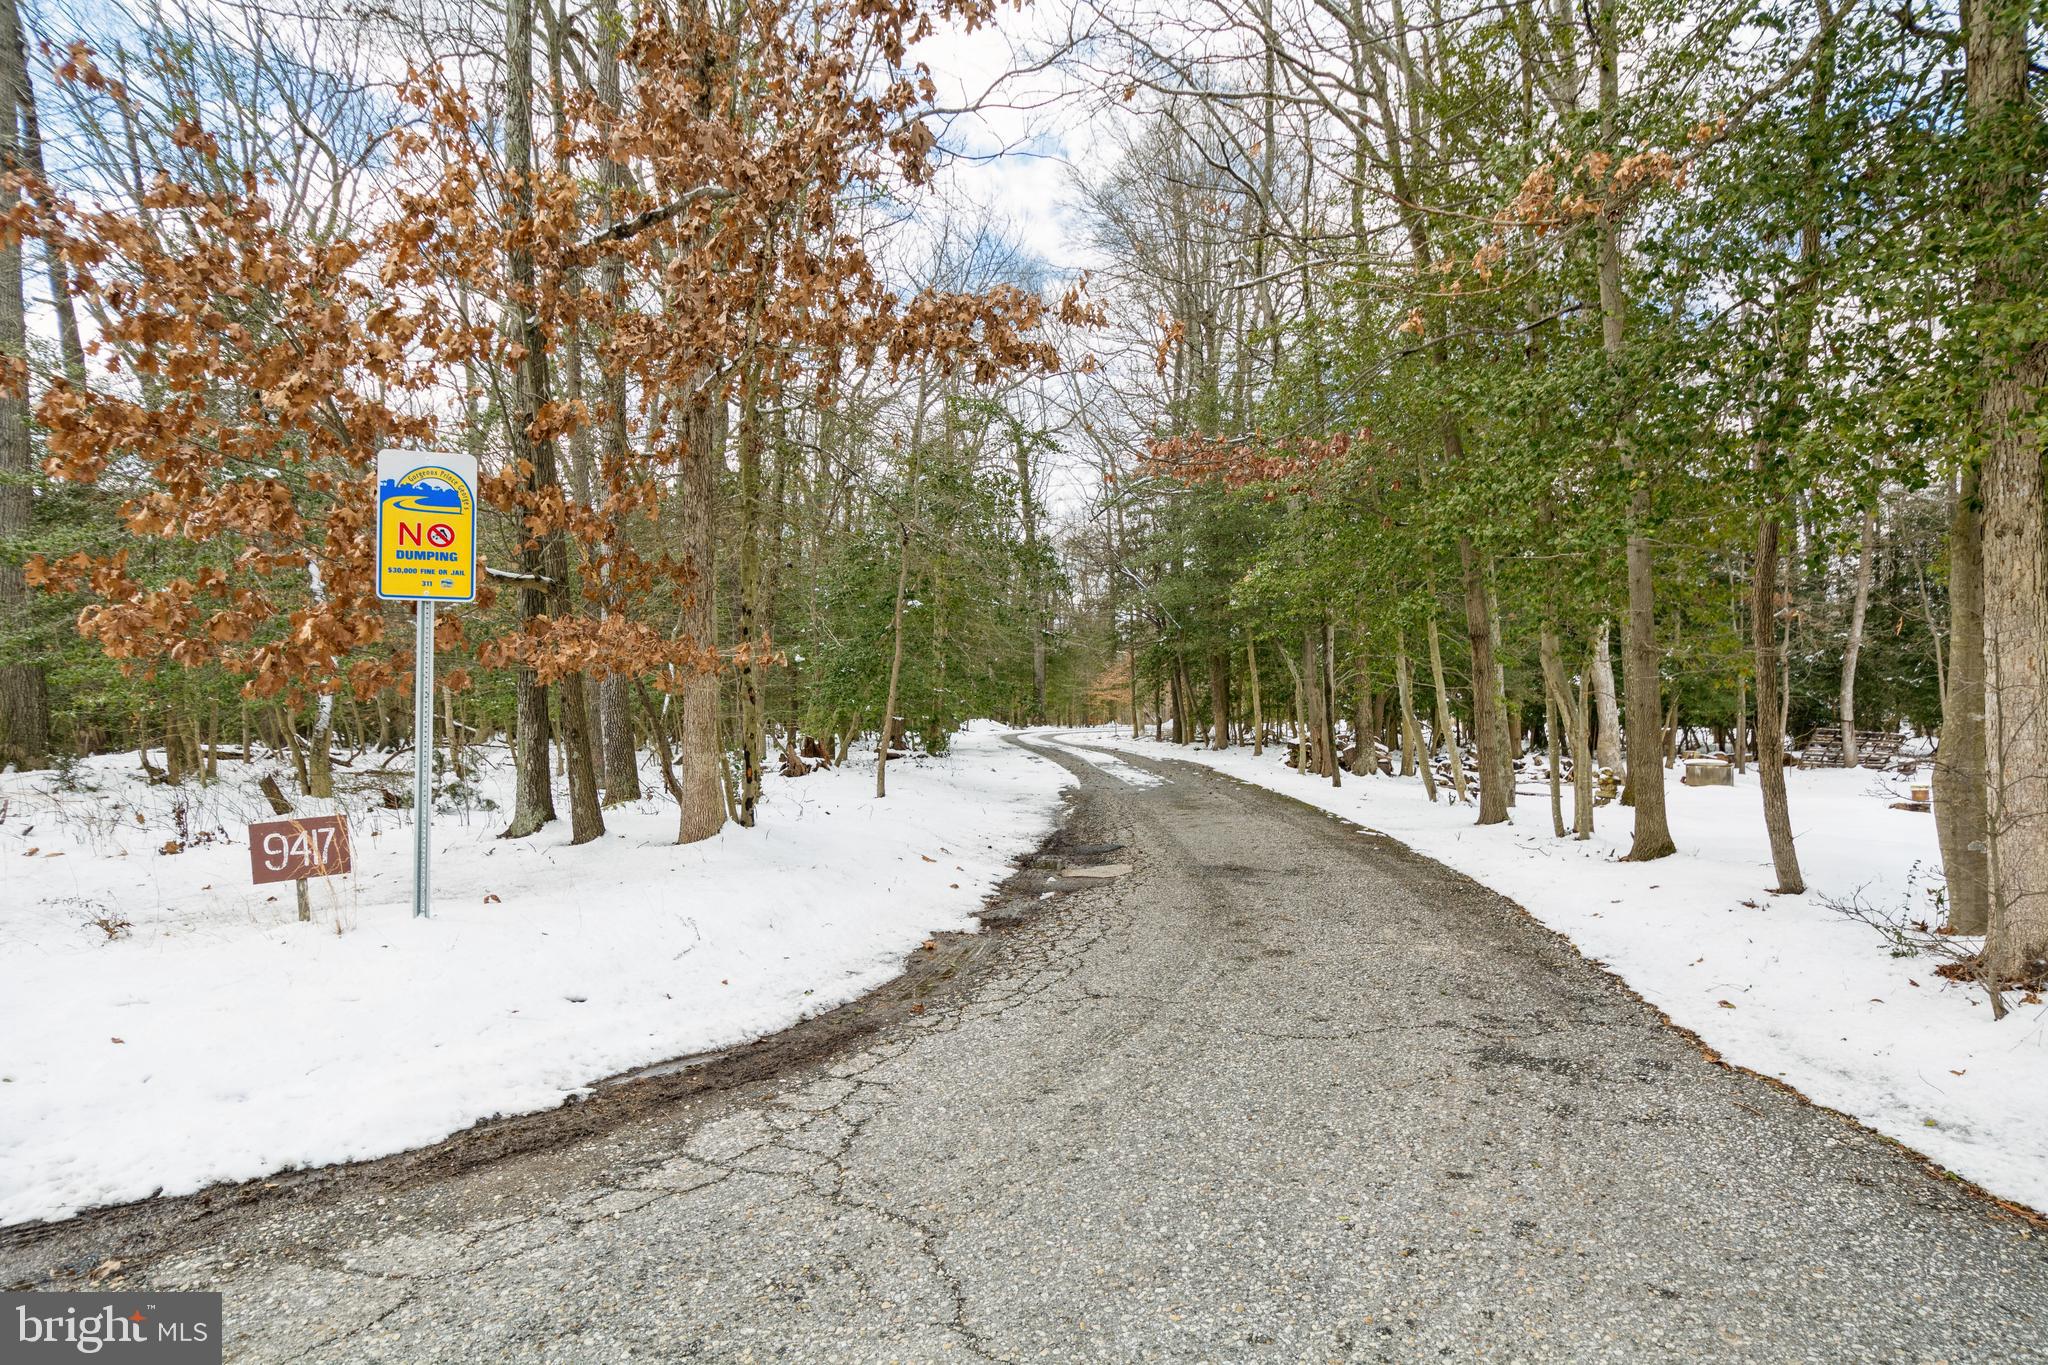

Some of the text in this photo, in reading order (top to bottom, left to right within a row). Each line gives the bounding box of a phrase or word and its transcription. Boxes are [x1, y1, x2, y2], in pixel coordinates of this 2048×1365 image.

[439, 470, 458, 485] Prince
[396, 549, 458, 562] DUMPING
[387, 567, 418, 575] $30,000
[263, 827, 336, 871] 9417
